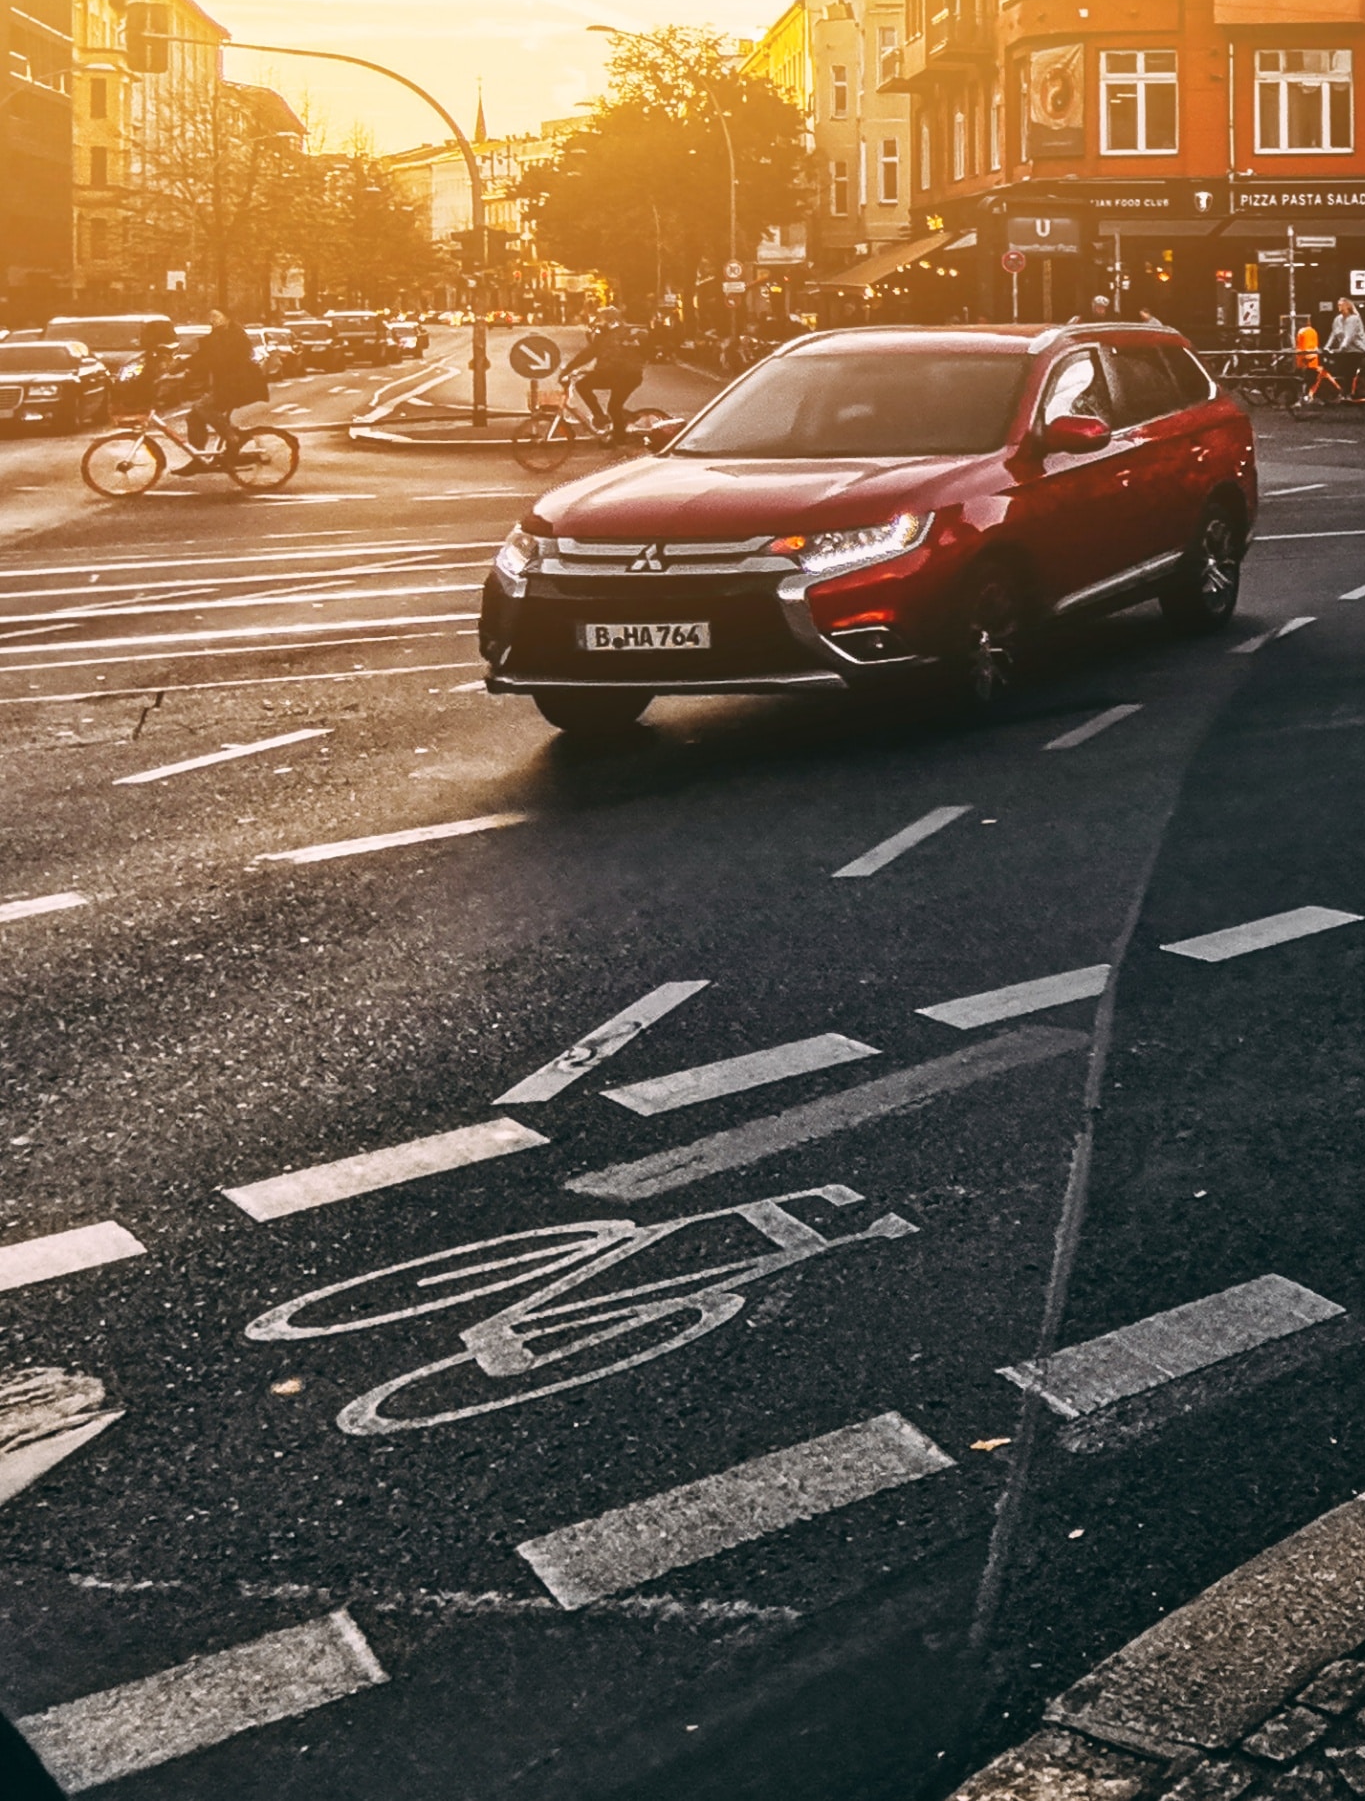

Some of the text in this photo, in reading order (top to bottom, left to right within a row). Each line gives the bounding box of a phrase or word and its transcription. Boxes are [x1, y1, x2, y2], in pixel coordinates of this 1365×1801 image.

[1114, 199, 1141, 207] FOOD
[1143, 198, 1169, 207] CLUB
[1240, 194, 1277, 207] PIZZA
[1281, 194, 1322, 206] PASTA
[1035, 218, 1051, 237] U
[595, 626, 610, 648] B
[656, 625, 699, 647] 764
